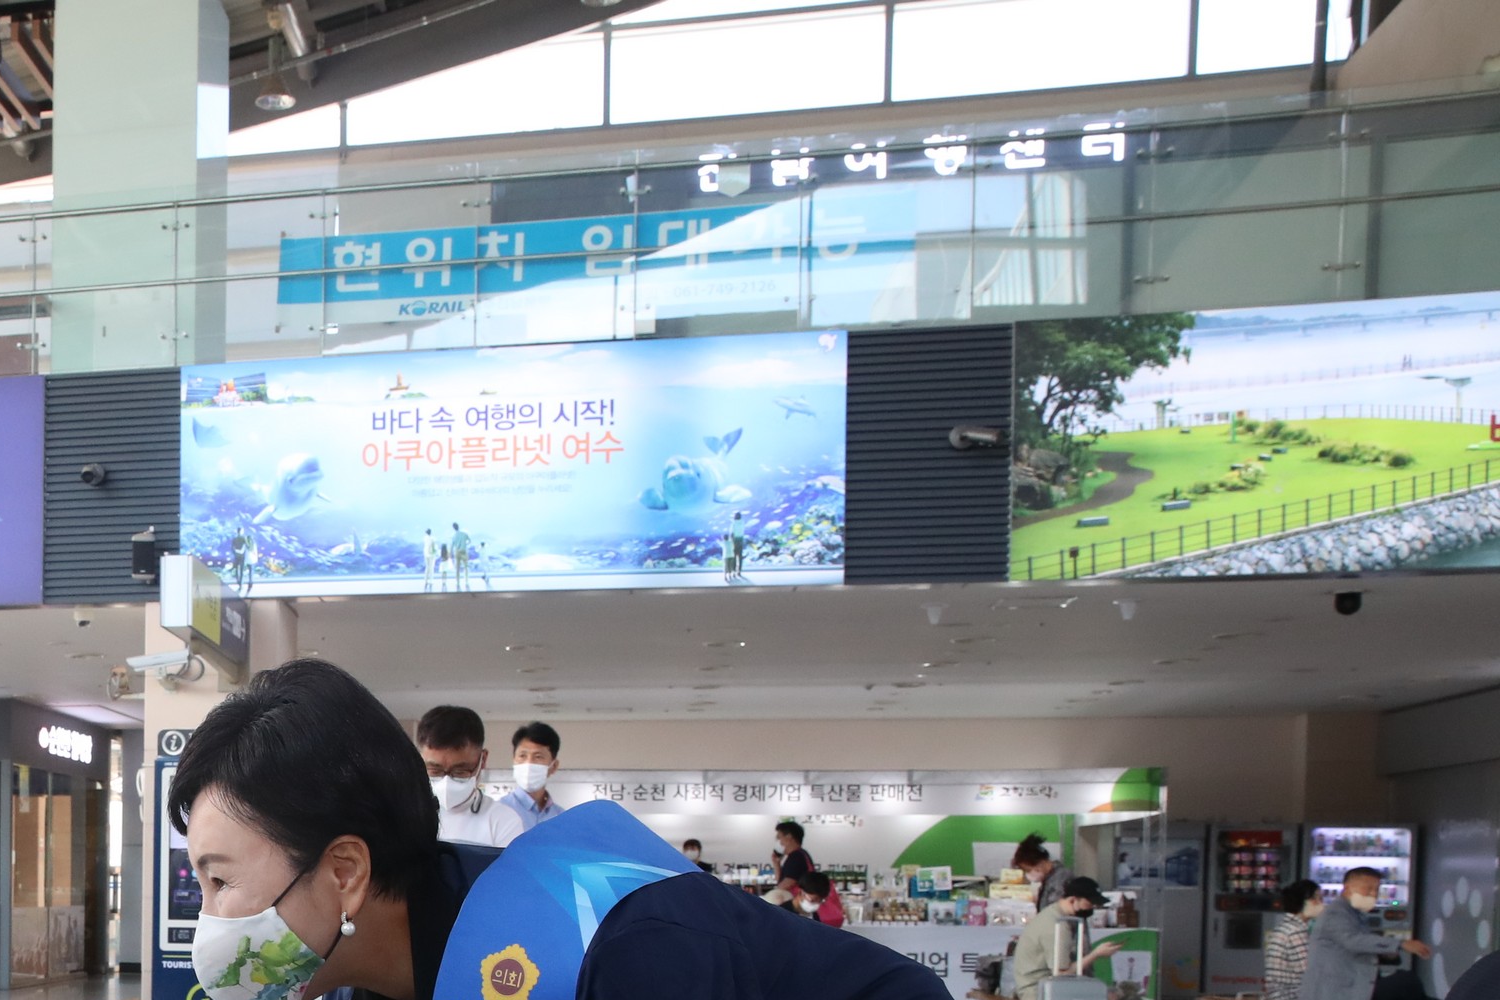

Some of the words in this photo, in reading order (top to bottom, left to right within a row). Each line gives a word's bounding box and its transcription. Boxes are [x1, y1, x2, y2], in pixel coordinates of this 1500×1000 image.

[333, 231, 525, 292] 현위치
[674, 280, 776, 298] 061-749-2126
[399, 300, 465, 316] KORAIL
[372, 408, 423, 435] 바다
[428, 406, 455, 432] 속
[465, 402, 542, 431] 여행의
[553, 399, 615, 426] 시작!
[362, 433, 551, 472] 아쿠아플라넷
[562, 430, 624, 464] 여수
[673, 783, 725, 801] 사회적
[731, 783, 801, 801] 경제기업
[809, 783, 862, 802] 특산물
[869, 783, 923, 801] 판매전
[492, 969, 523, 989] 의회
